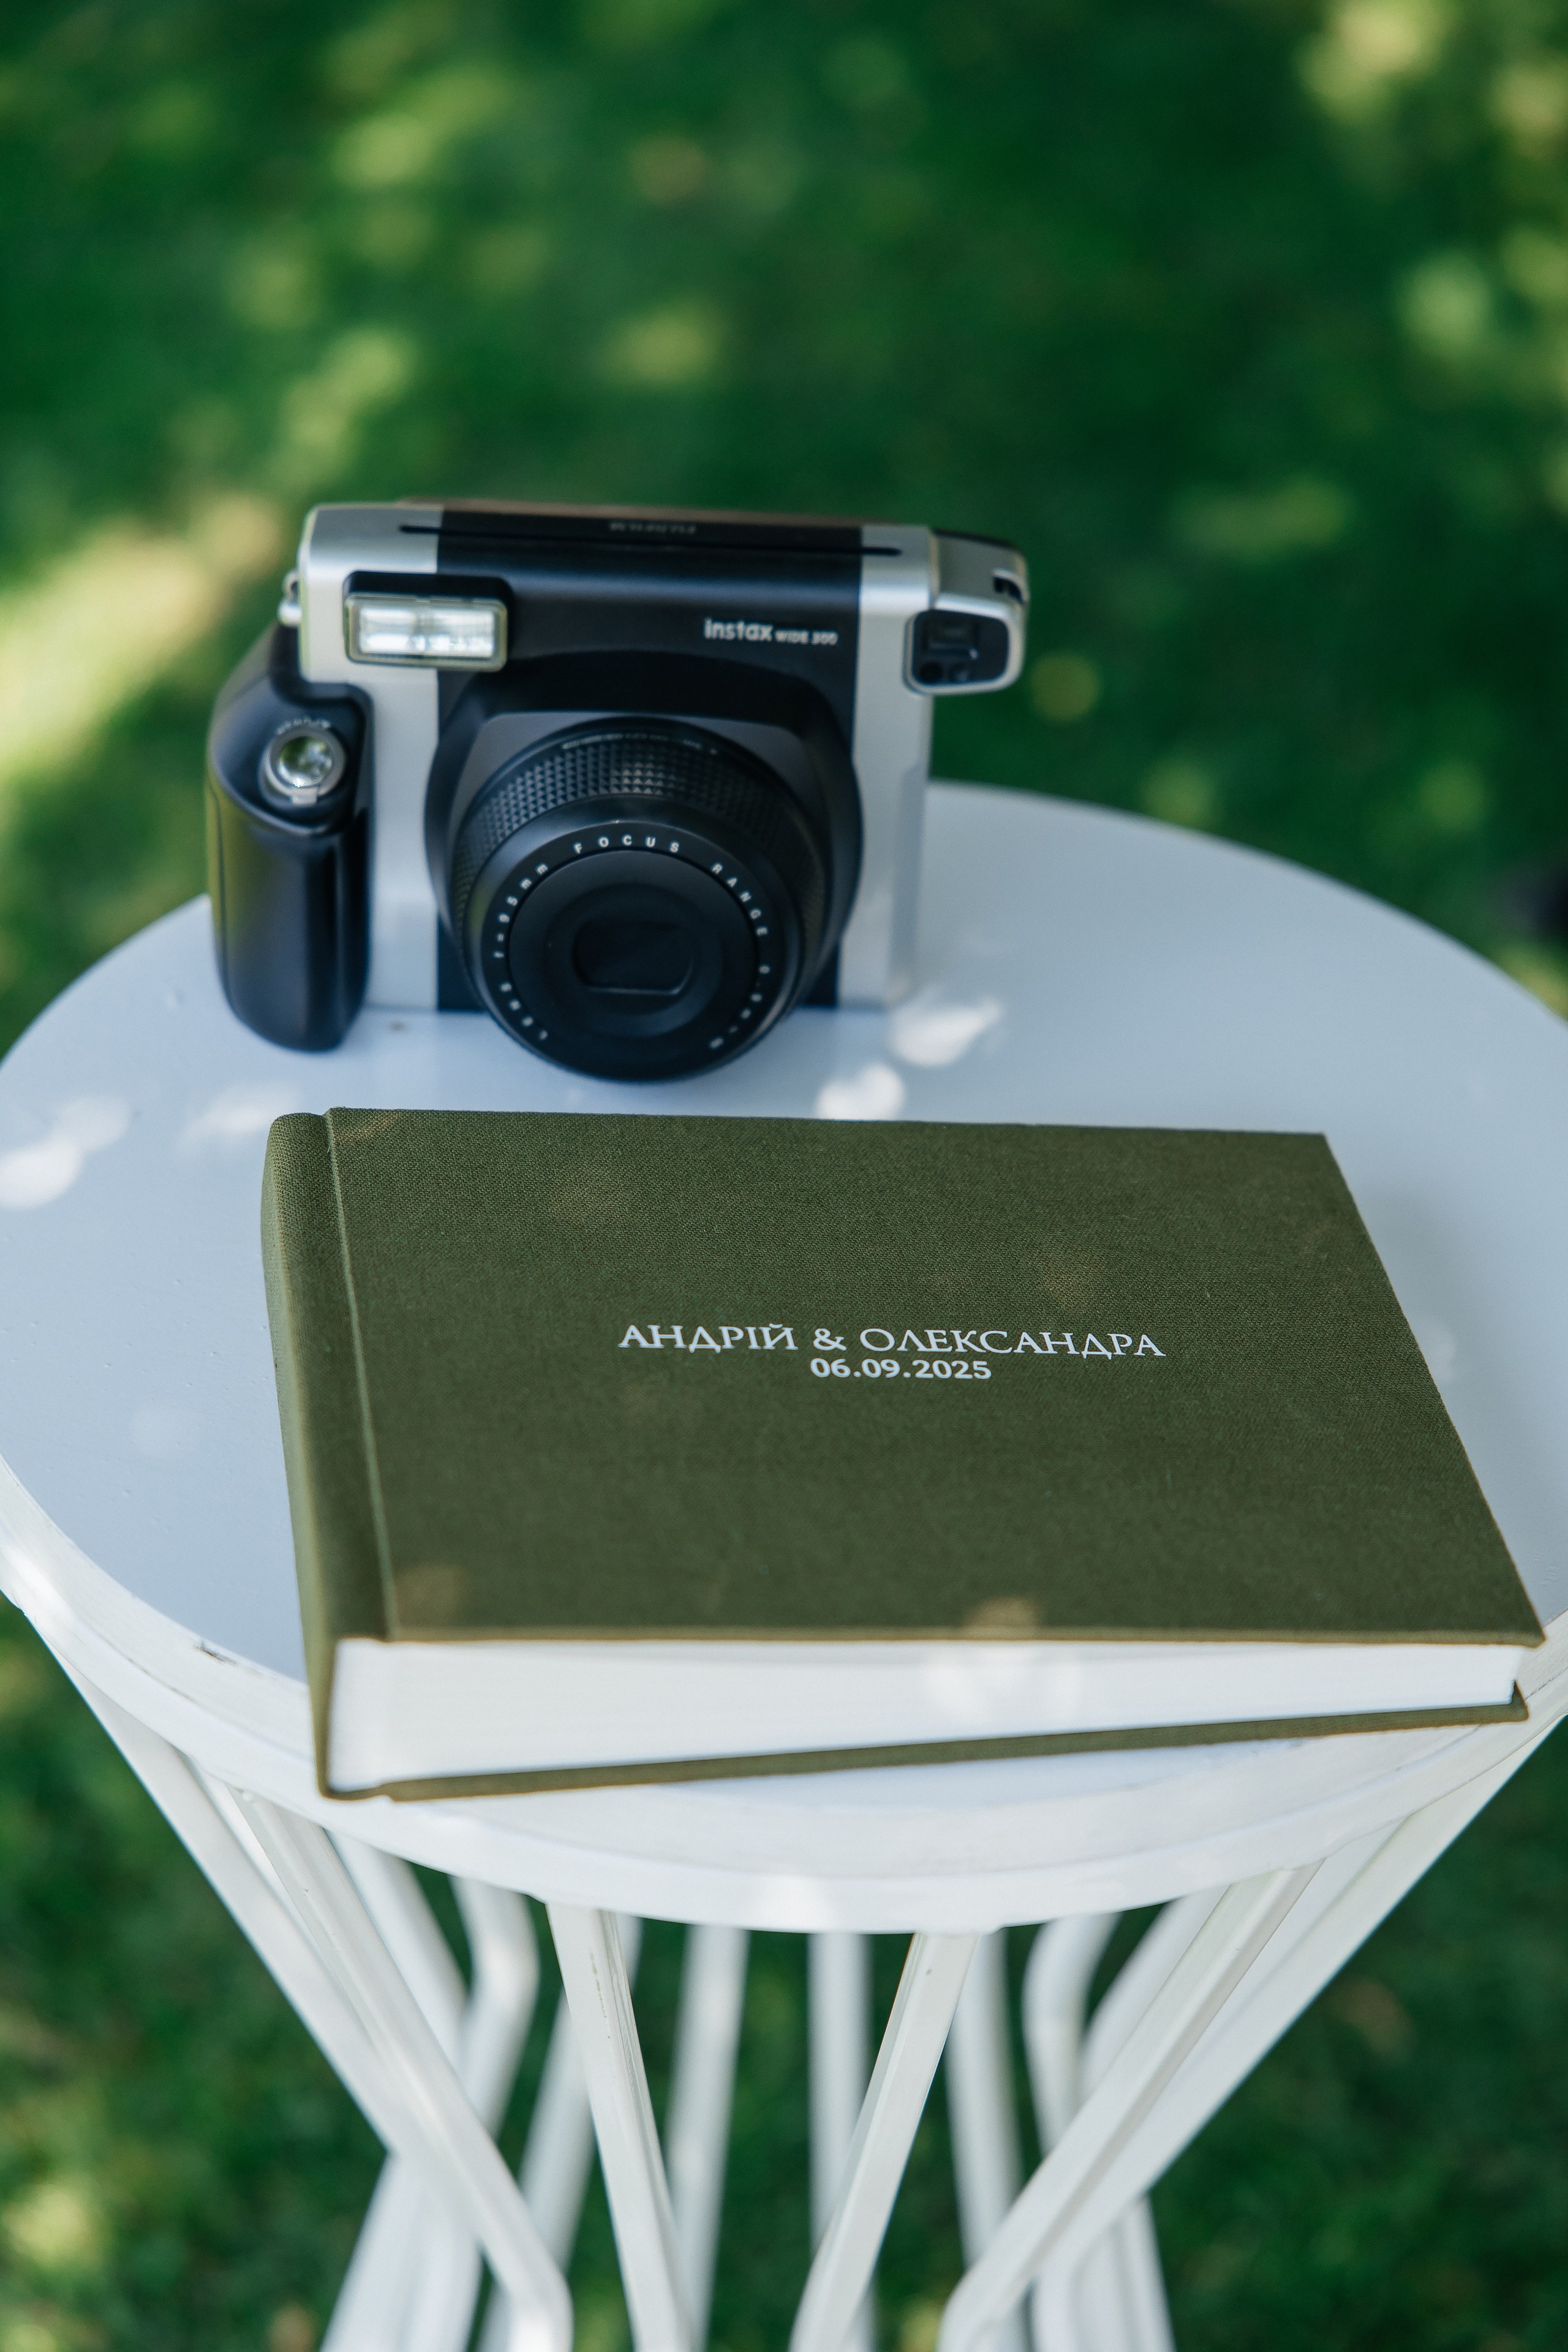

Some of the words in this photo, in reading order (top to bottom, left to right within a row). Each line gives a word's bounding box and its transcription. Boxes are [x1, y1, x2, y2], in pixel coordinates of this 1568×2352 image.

[703, 618, 773, 641] instax
[572, 834, 680, 854] FOCUS
[711, 862, 768, 937] RANGE
[617, 1323, 799, 1354] АНДРІЙ
[812, 1328, 847, 1351] &
[859, 1328, 1167, 1360] ОЛЕКСАНДРА
[809, 1357, 992, 1379] 06.09.2025
